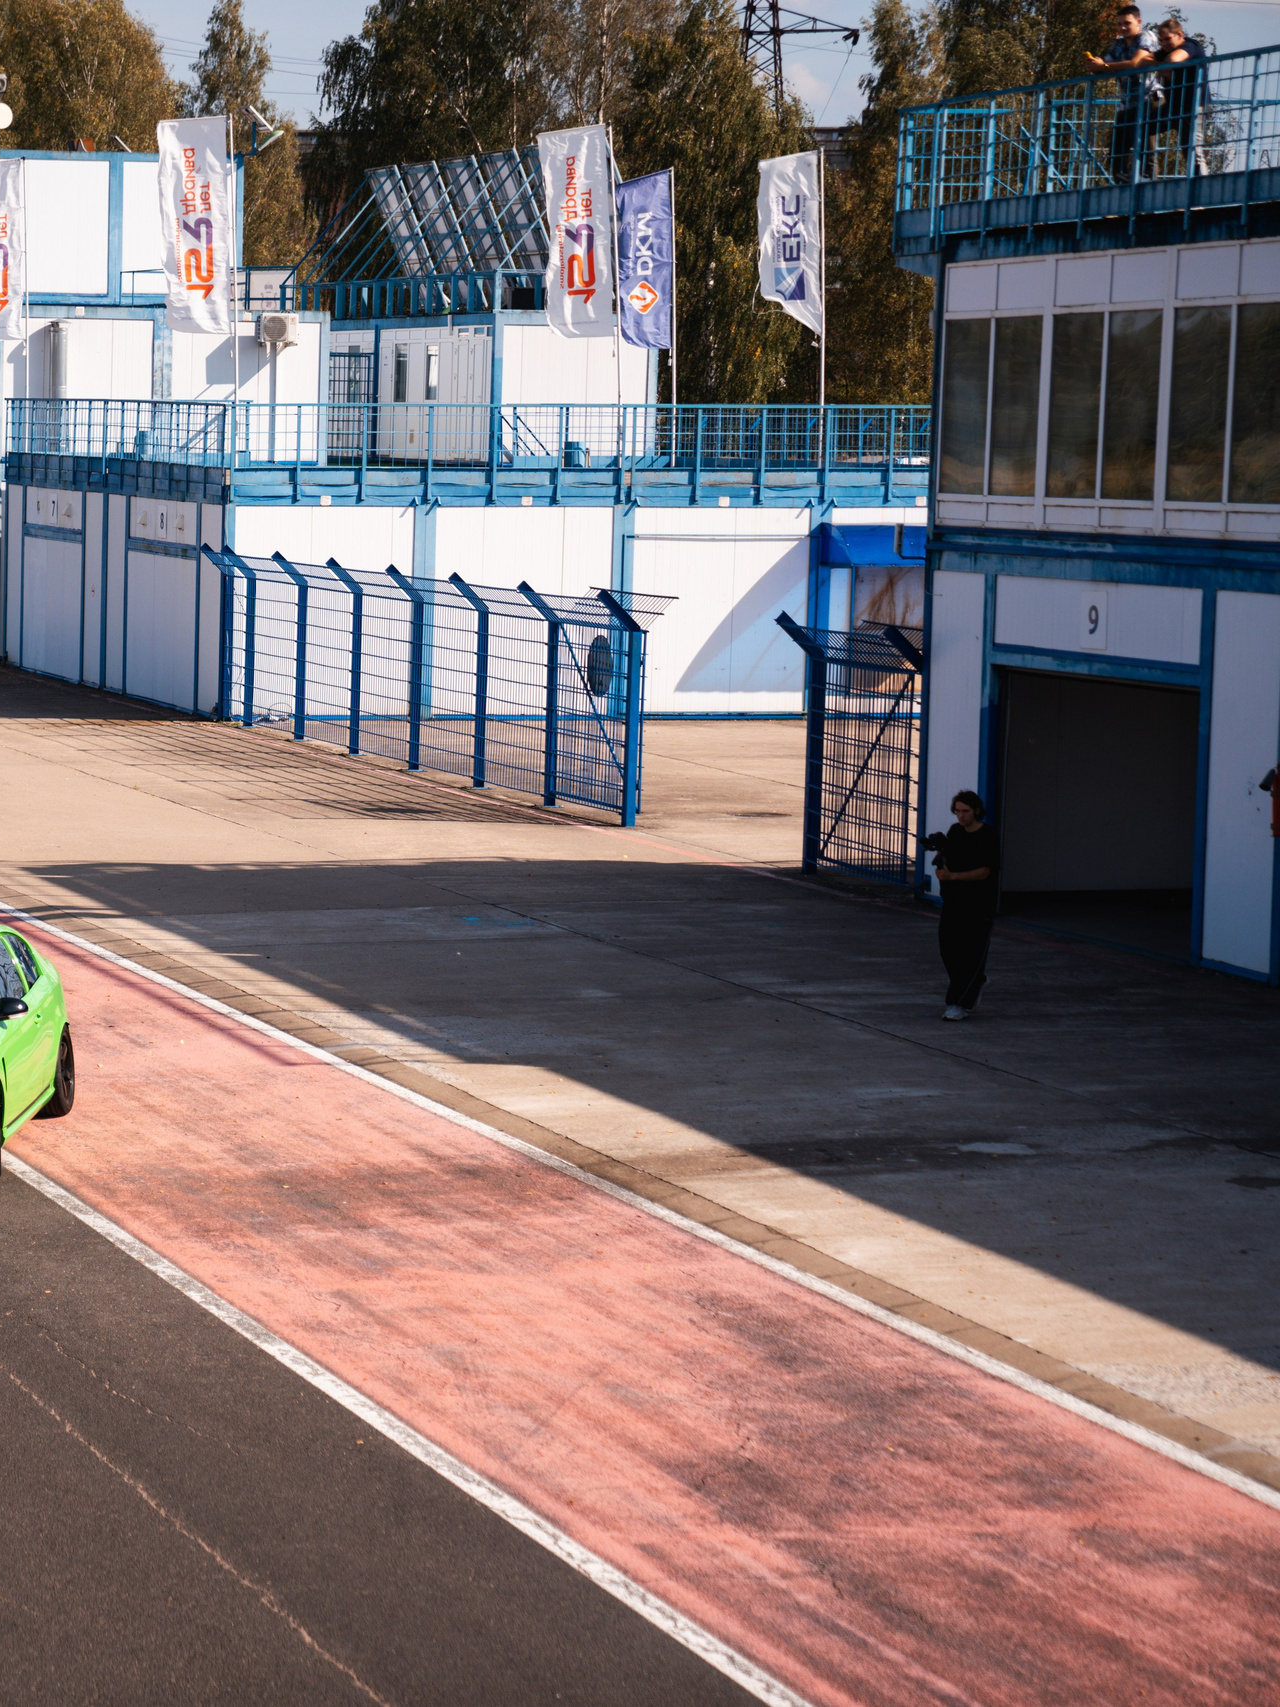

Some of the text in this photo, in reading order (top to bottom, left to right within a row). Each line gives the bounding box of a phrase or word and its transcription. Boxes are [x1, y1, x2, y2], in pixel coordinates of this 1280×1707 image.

[51, 500, 56, 517] 7
[160, 512, 165, 530] 8
[1088, 604, 1099, 635] 9
